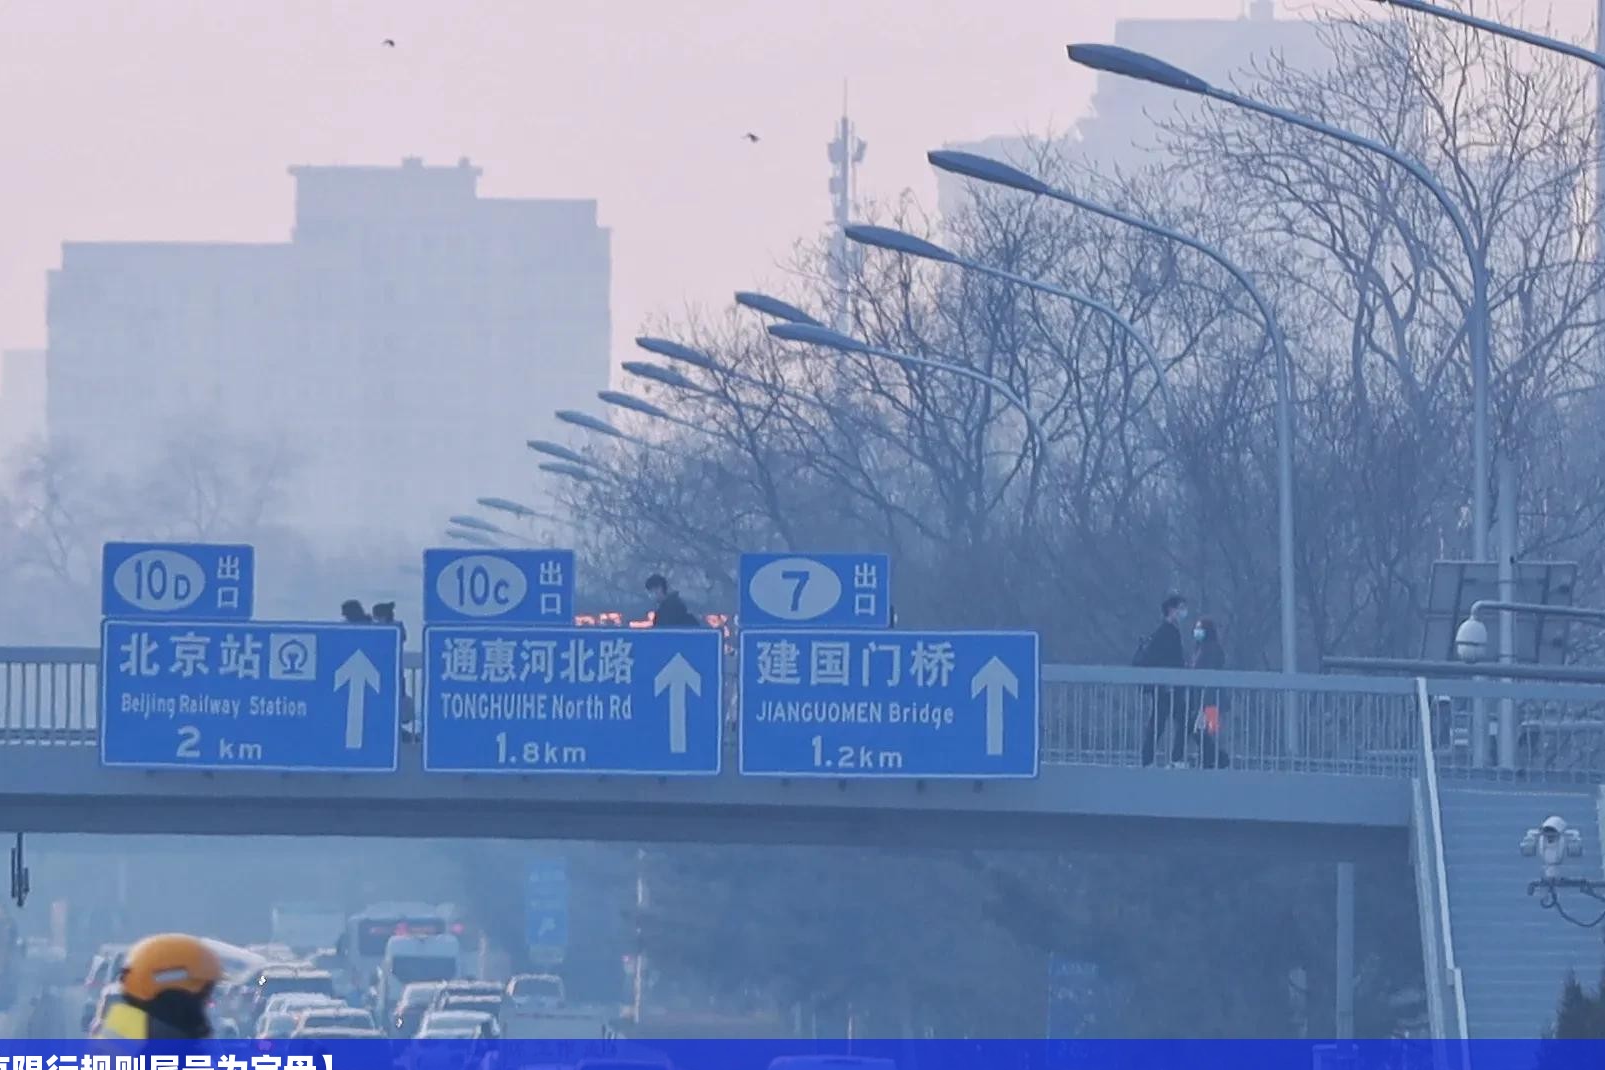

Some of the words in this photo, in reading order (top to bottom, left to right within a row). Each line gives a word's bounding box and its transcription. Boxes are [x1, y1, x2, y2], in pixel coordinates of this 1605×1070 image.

[133, 559, 192, 601] 10D
[216, 553, 241, 609] 出口
[539, 559, 564, 616] 出口
[780, 569, 811, 613] 7
[853, 562, 877, 616] 出口
[119, 631, 264, 680] 北京站
[441, 637, 635, 686] 通惠河北路
[755, 639, 956, 688] 建国门桥
[121, 692, 175, 720] Beijing
[179, 693, 241, 718] Railway
[249, 695, 308, 717] Station
[441, 692, 547, 721] TONGHUIHE
[551, 692, 604, 721] North
[609, 693, 633, 721] Rd
[755, 700, 883, 724] JIANGUOMEN
[888, 701, 955, 731] Bridge
[176, 725, 201, 758] 2
[219, 738, 263, 761] km
